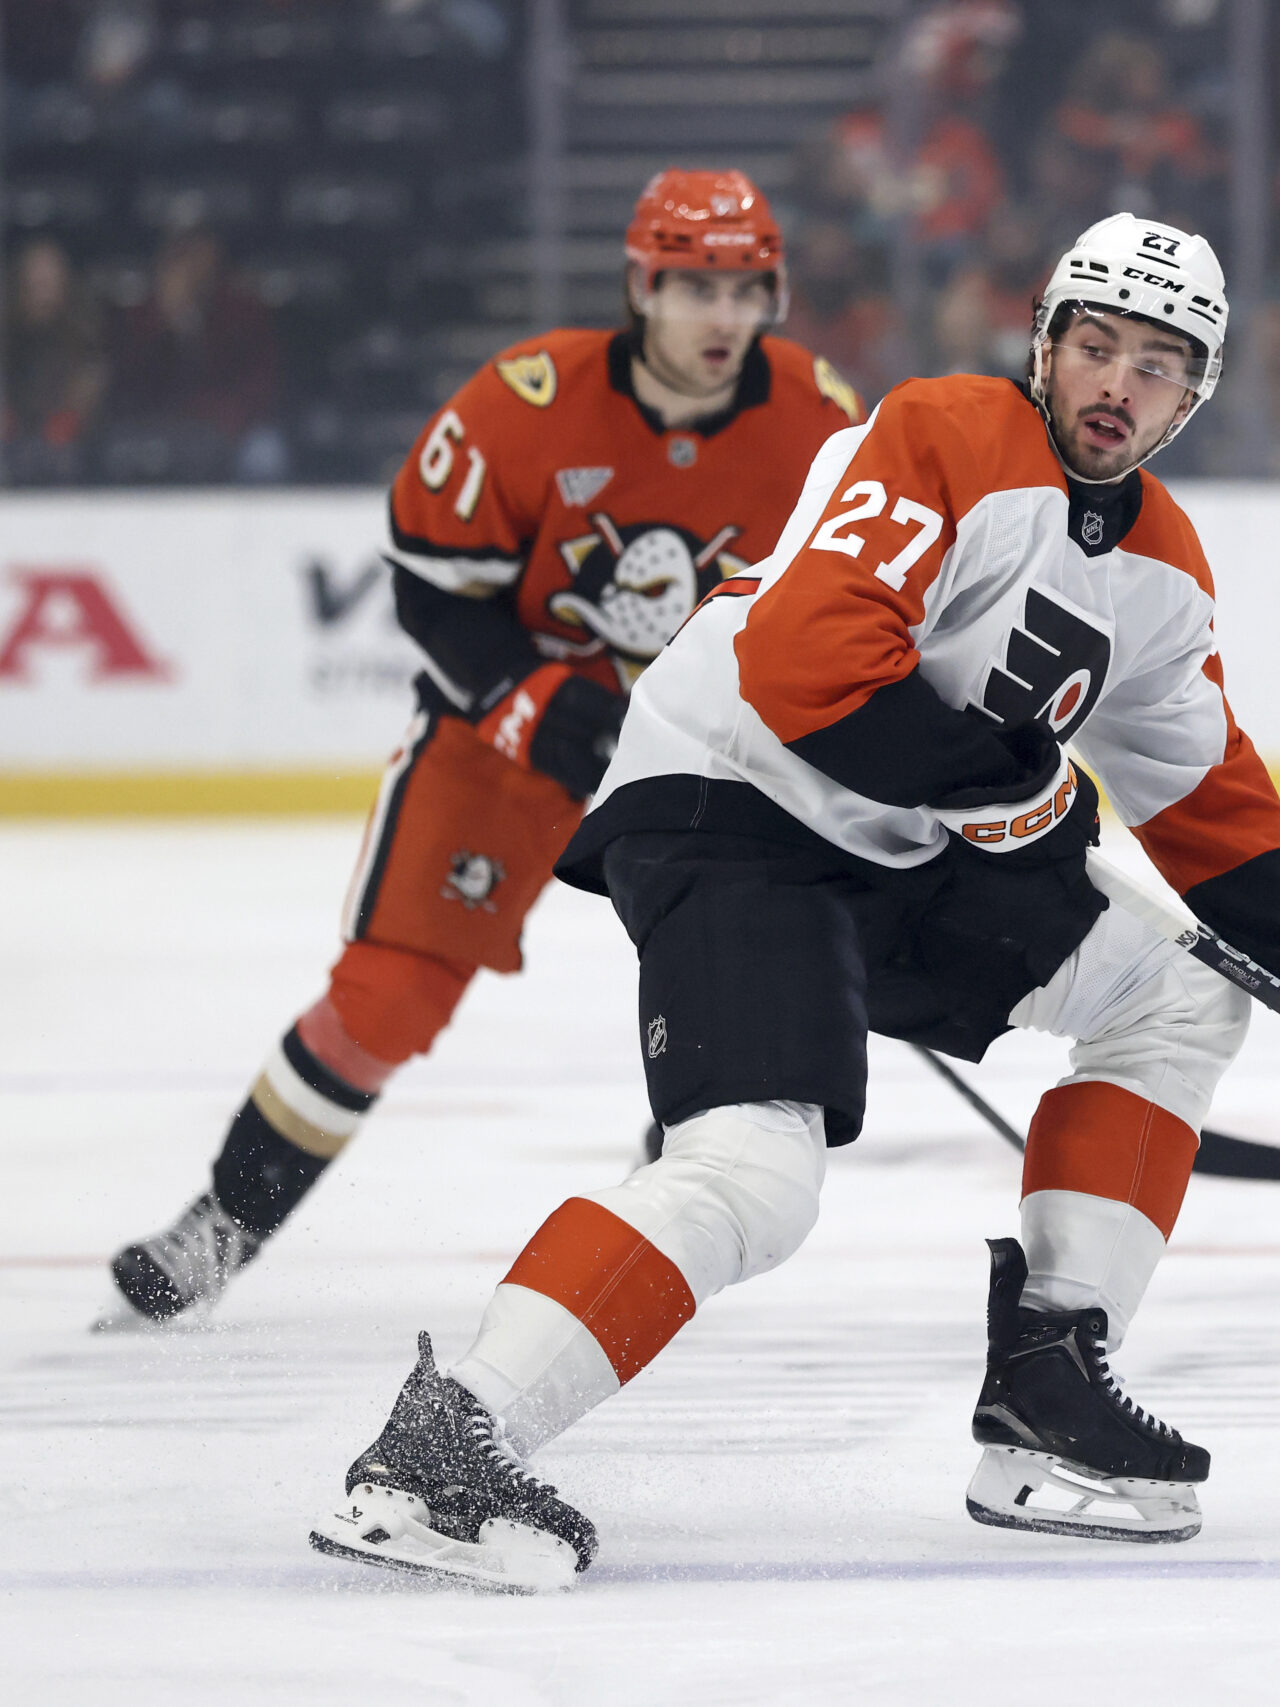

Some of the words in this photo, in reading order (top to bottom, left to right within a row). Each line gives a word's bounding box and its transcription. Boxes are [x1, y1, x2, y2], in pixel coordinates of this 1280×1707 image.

[1142, 231, 1181, 256] 27
[1122, 266, 1186, 293] CCM
[419, 409, 486, 523] 61
[809, 480, 944, 592] 27
[961, 762, 1078, 843] CCM
[1222, 958, 1261, 985] NANOLITE
